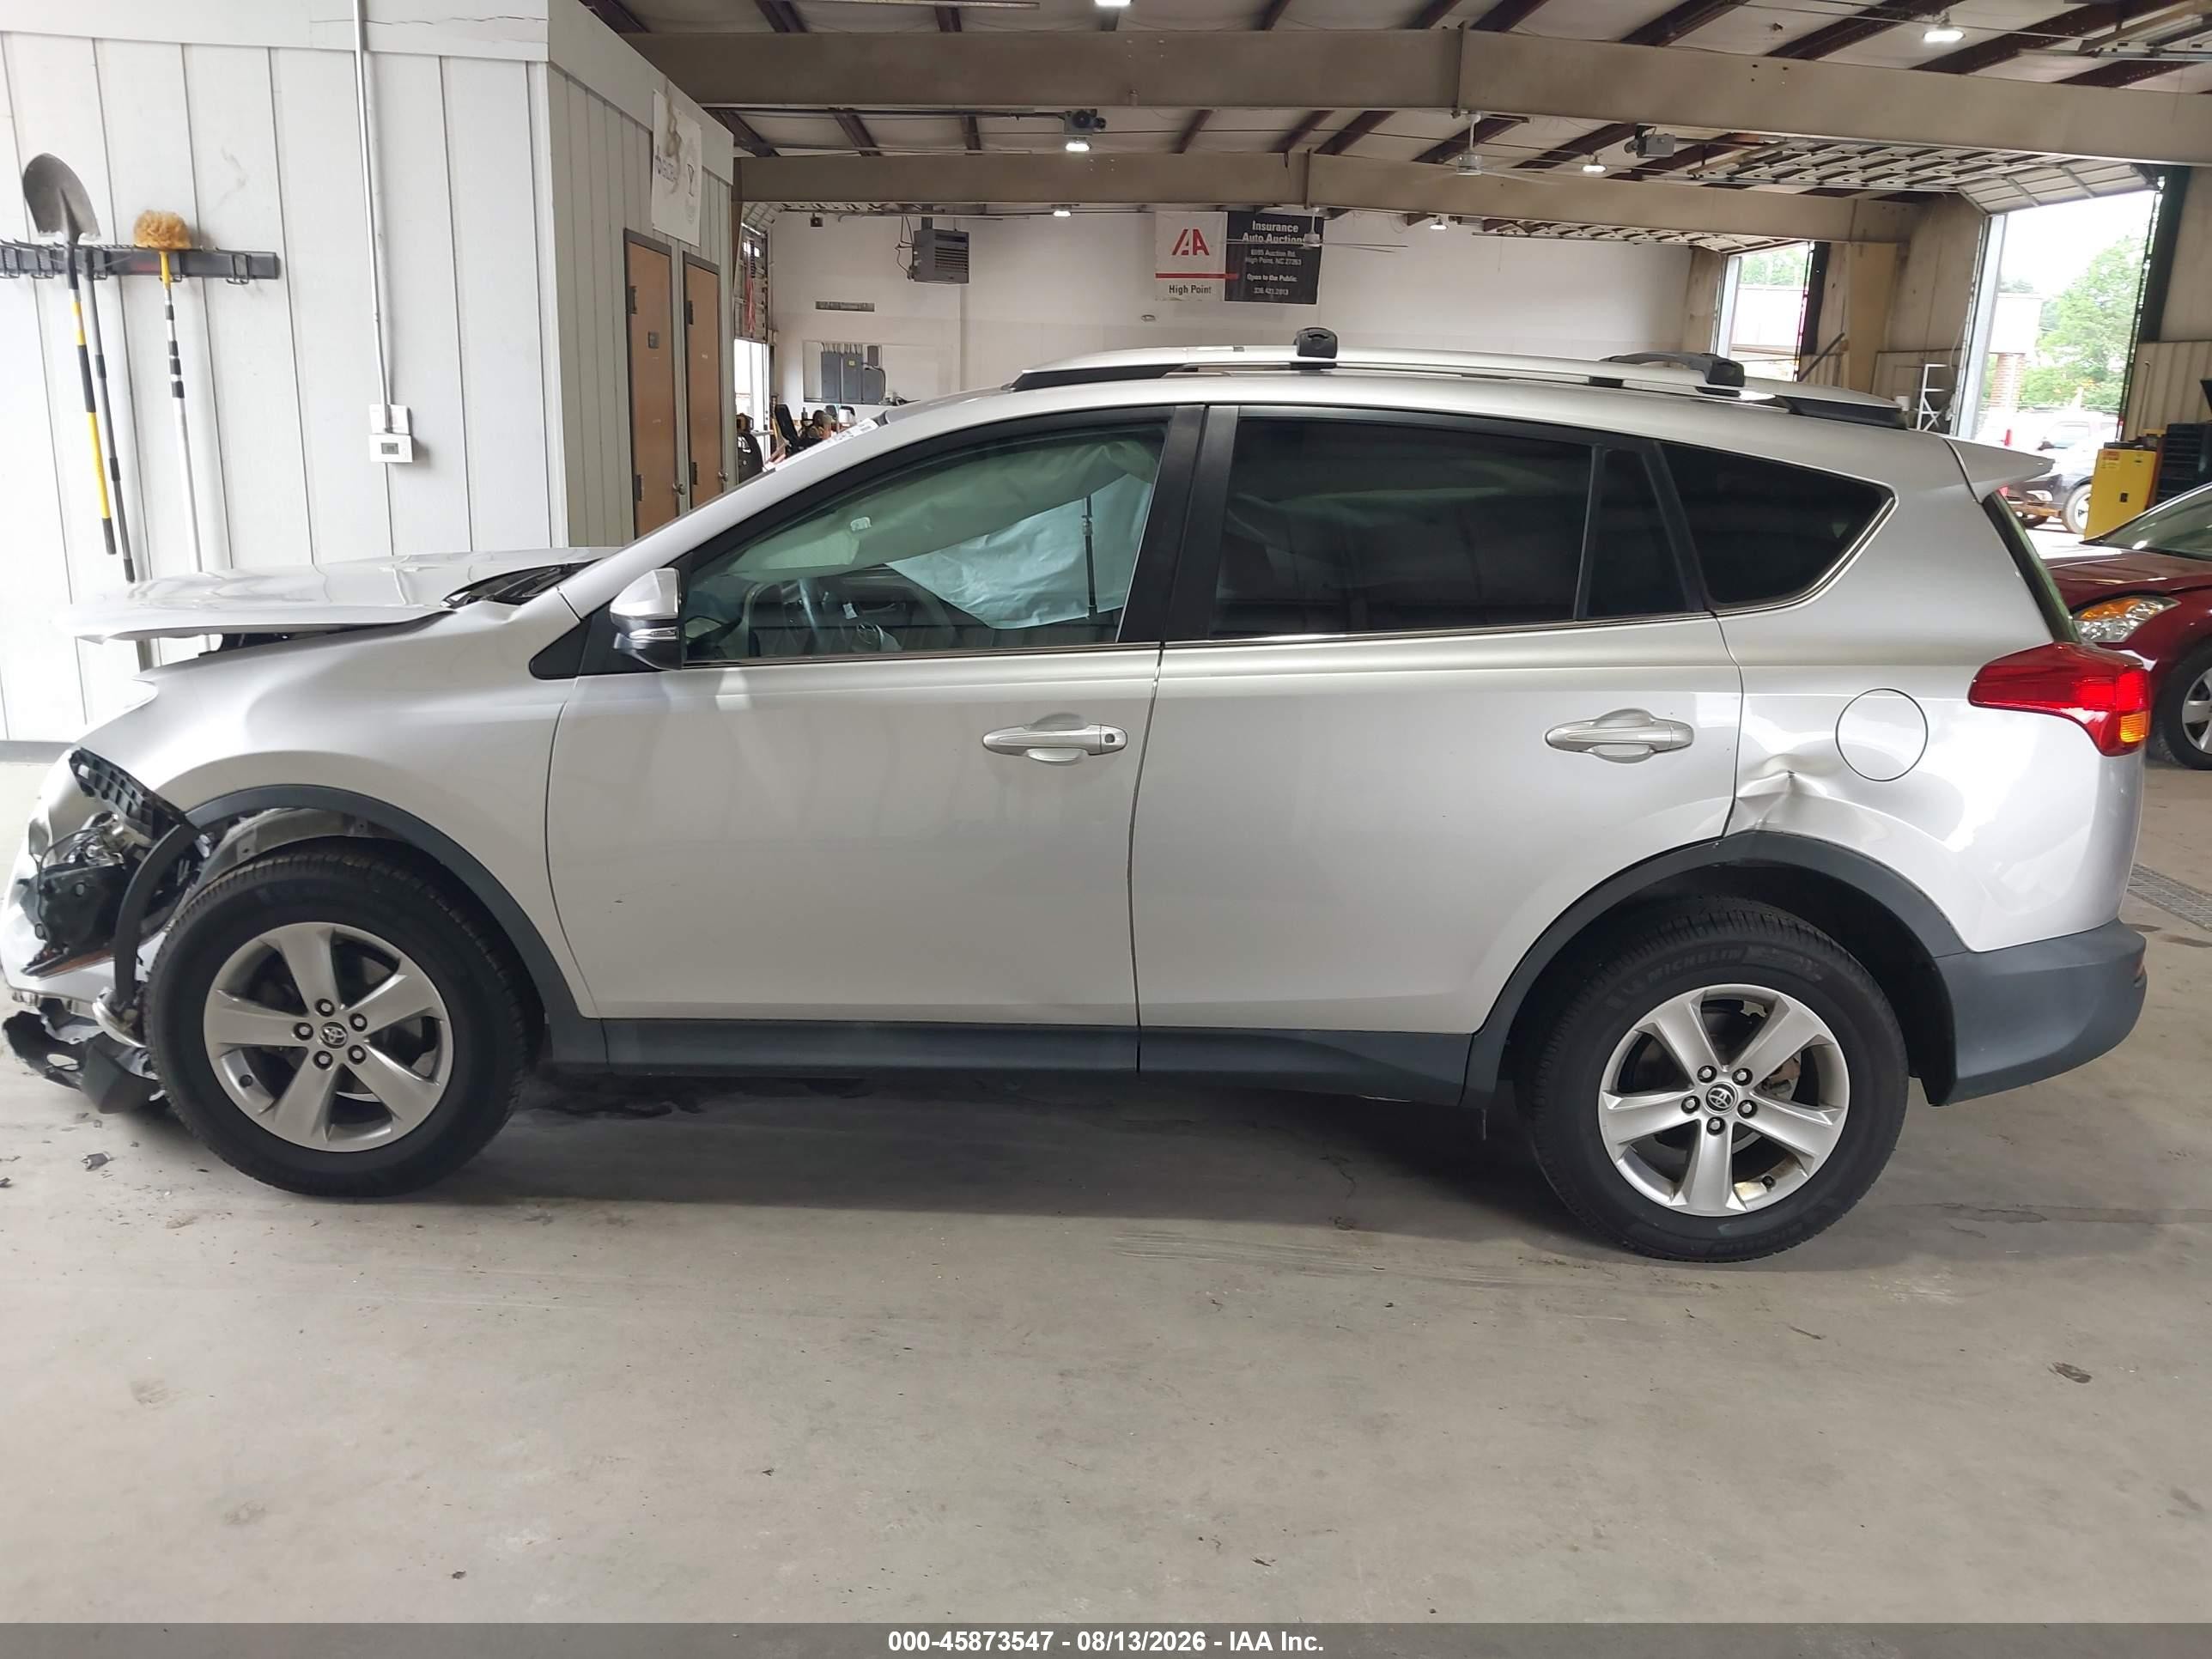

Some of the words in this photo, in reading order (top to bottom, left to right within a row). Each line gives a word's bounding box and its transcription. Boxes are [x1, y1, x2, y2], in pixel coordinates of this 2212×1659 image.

[1252, 220, 1299, 234] Insurance
[1243, 232, 1264, 243] Auto
[1247, 273, 1261, 282] Open
[1169, 284, 1188, 295] High
[1190, 284, 1212, 295] Point
[1647, 946, 1745, 983] MICHELIN
